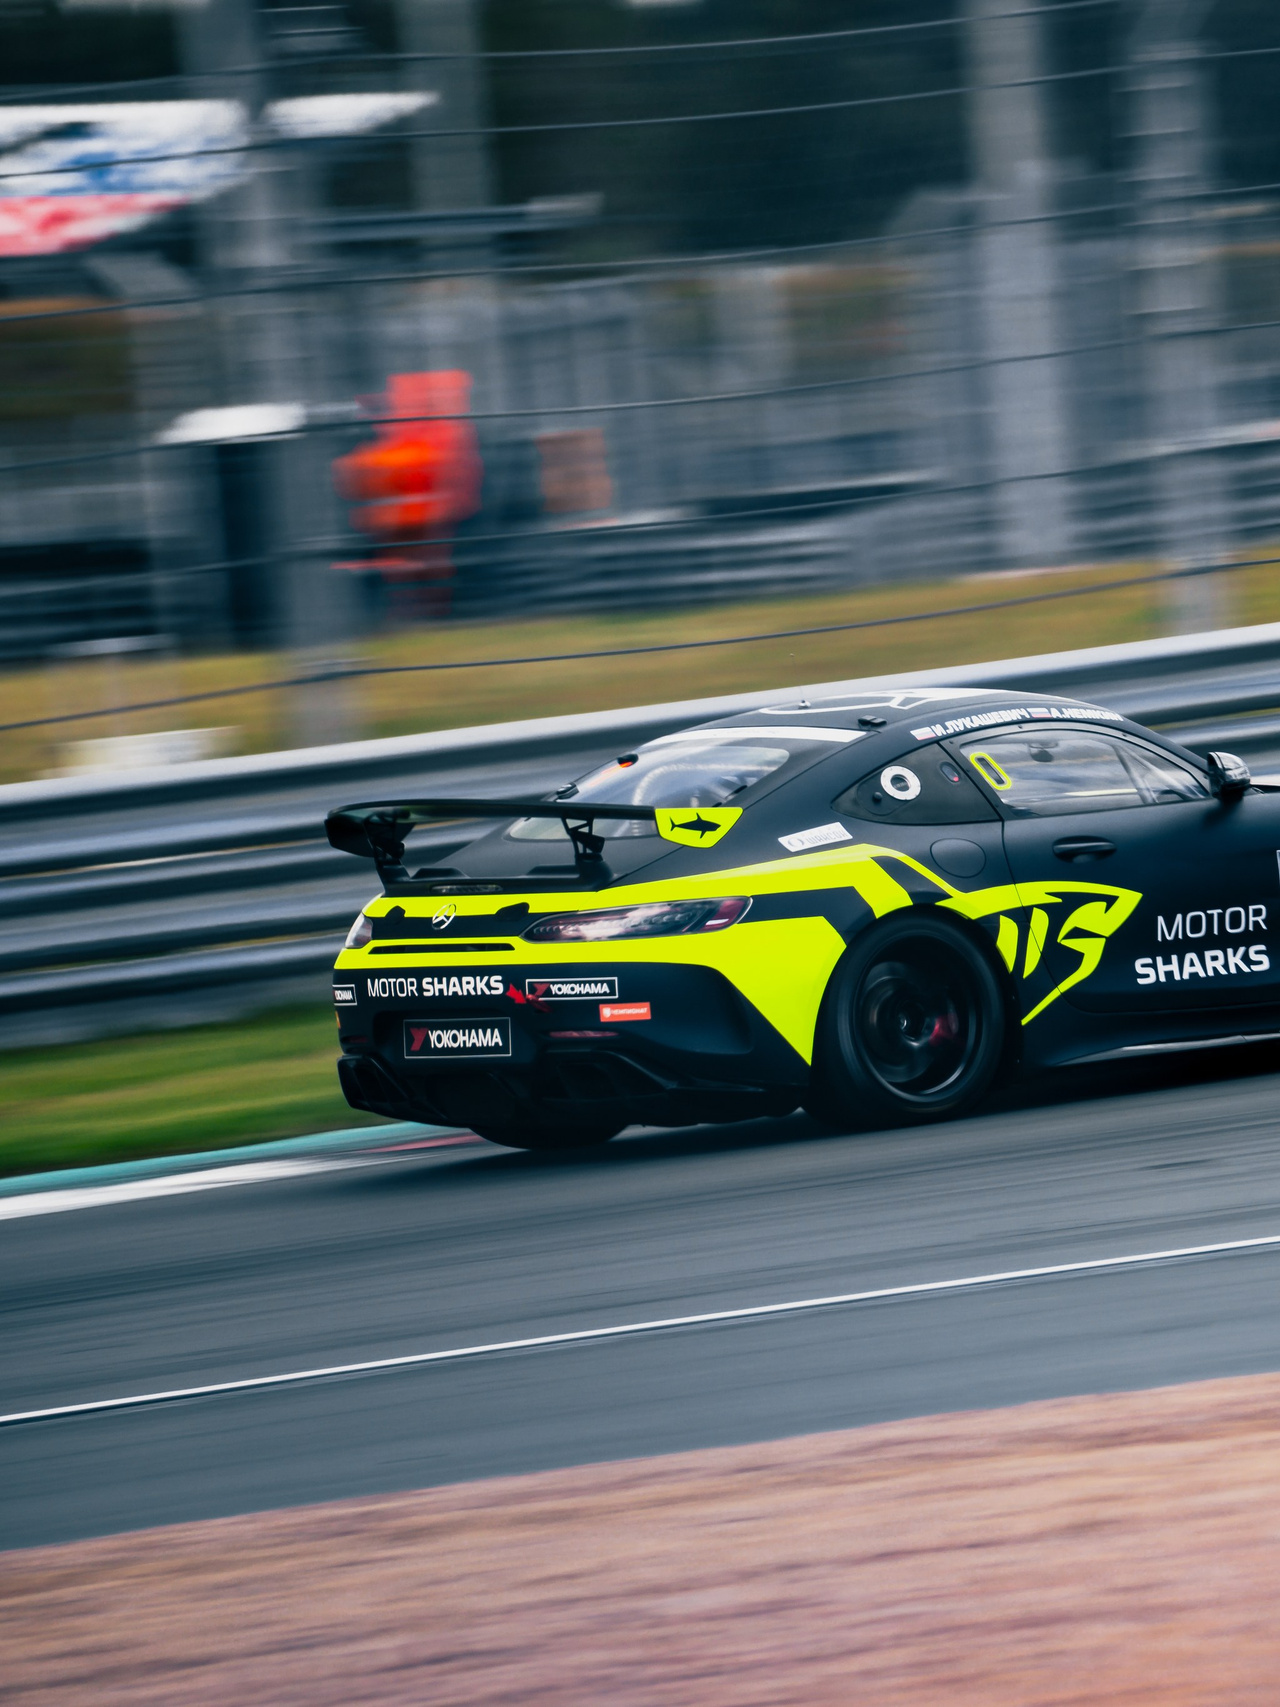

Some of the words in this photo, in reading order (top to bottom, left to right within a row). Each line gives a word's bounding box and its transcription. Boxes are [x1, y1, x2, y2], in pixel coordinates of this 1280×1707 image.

[1157, 904, 1267, 942] MOTOR
[1135, 945, 1270, 985] SHARKS
[367, 977, 418, 997] MOTOR
[422, 975, 503, 997] SHARKS
[550, 982, 610, 995] YOKOHAMA
[428, 1028, 502, 1049] YOKOHAMA
